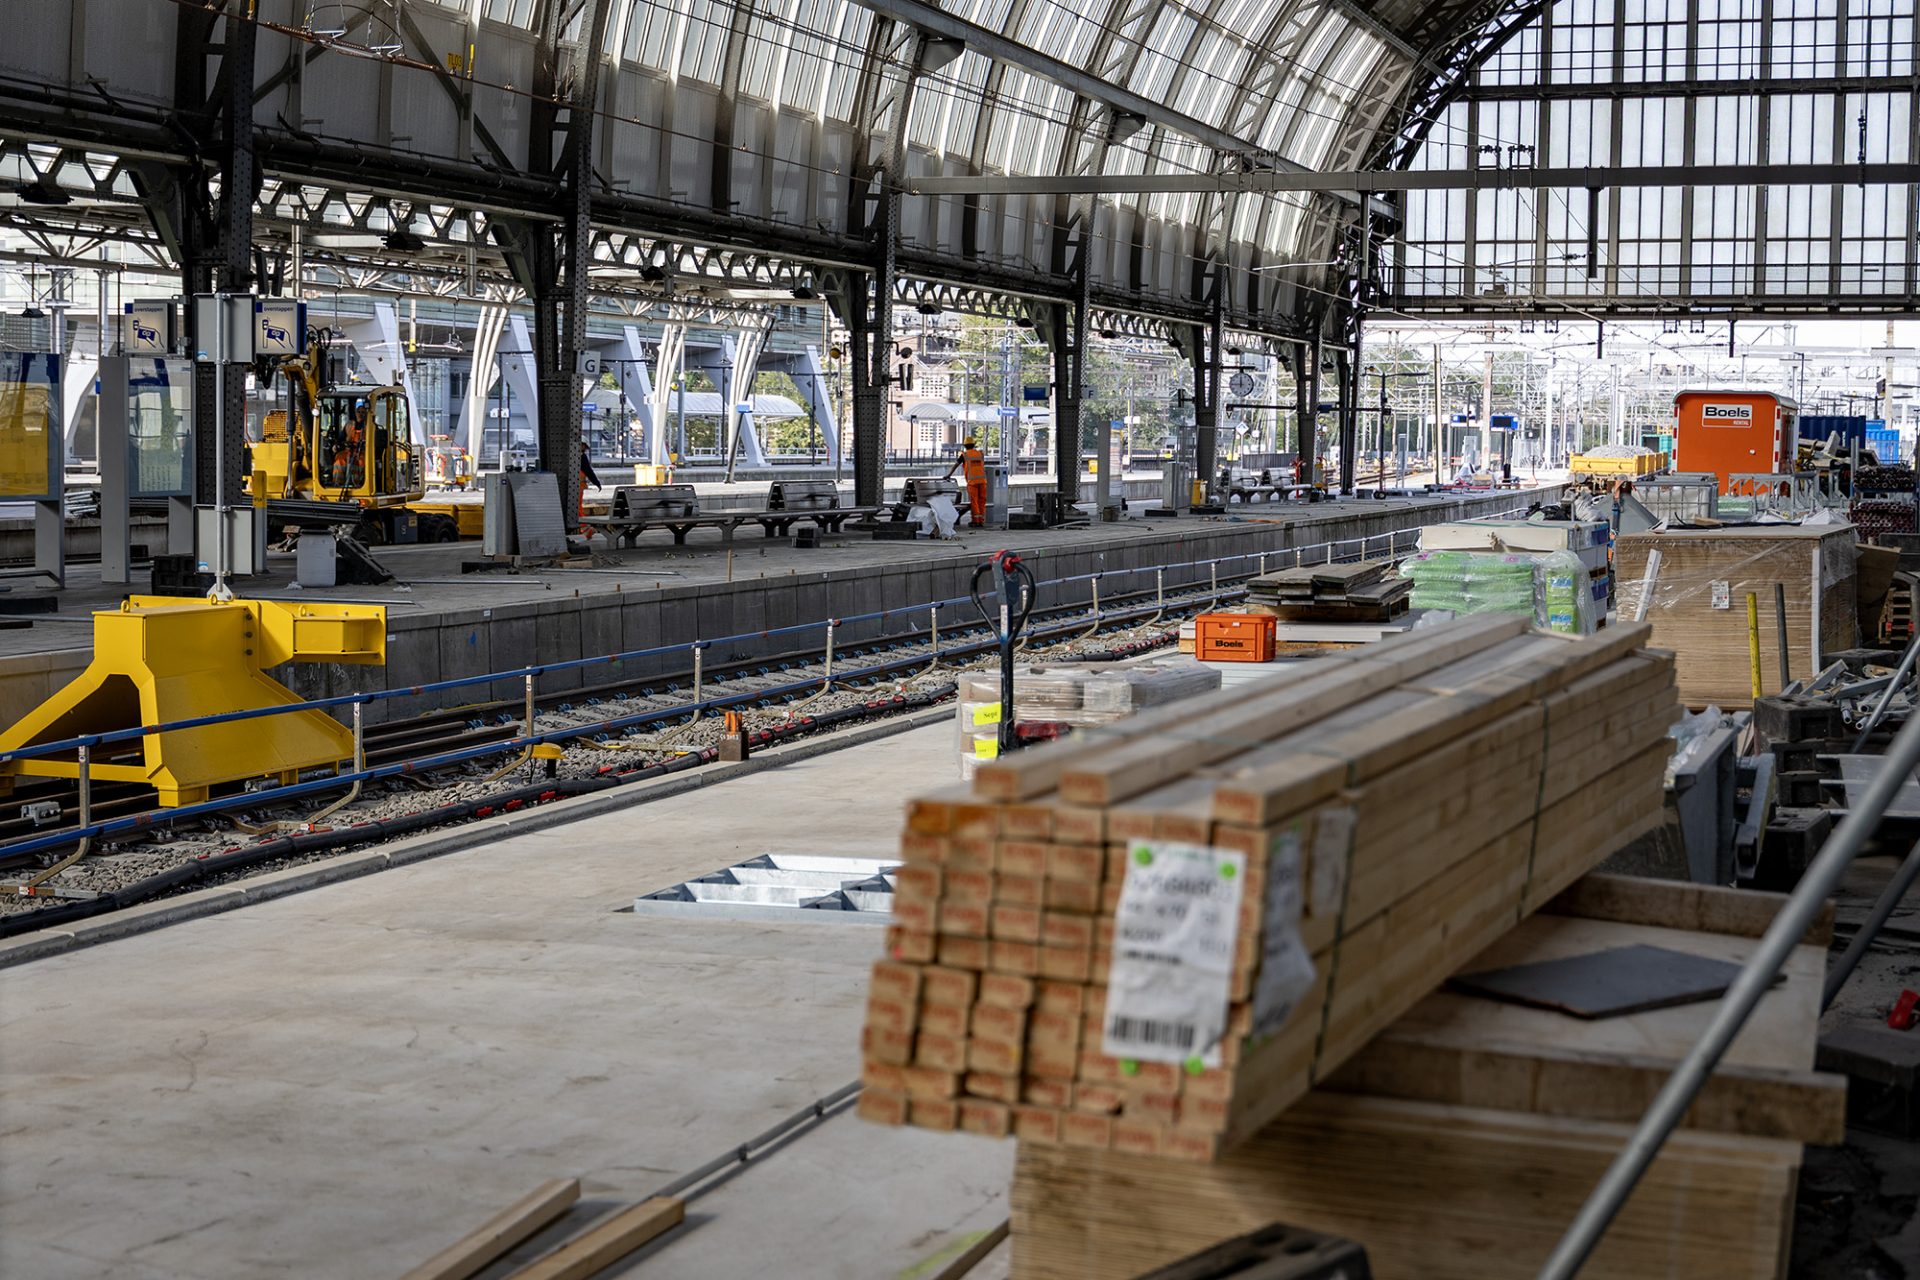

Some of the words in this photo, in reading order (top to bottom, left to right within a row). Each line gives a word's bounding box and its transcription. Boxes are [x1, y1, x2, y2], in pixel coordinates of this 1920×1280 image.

[584, 359, 596, 373] G
[1088, 390, 1095, 398] F
[1705, 406, 1749, 417] Boels
[1215, 640, 1244, 648] Boels
